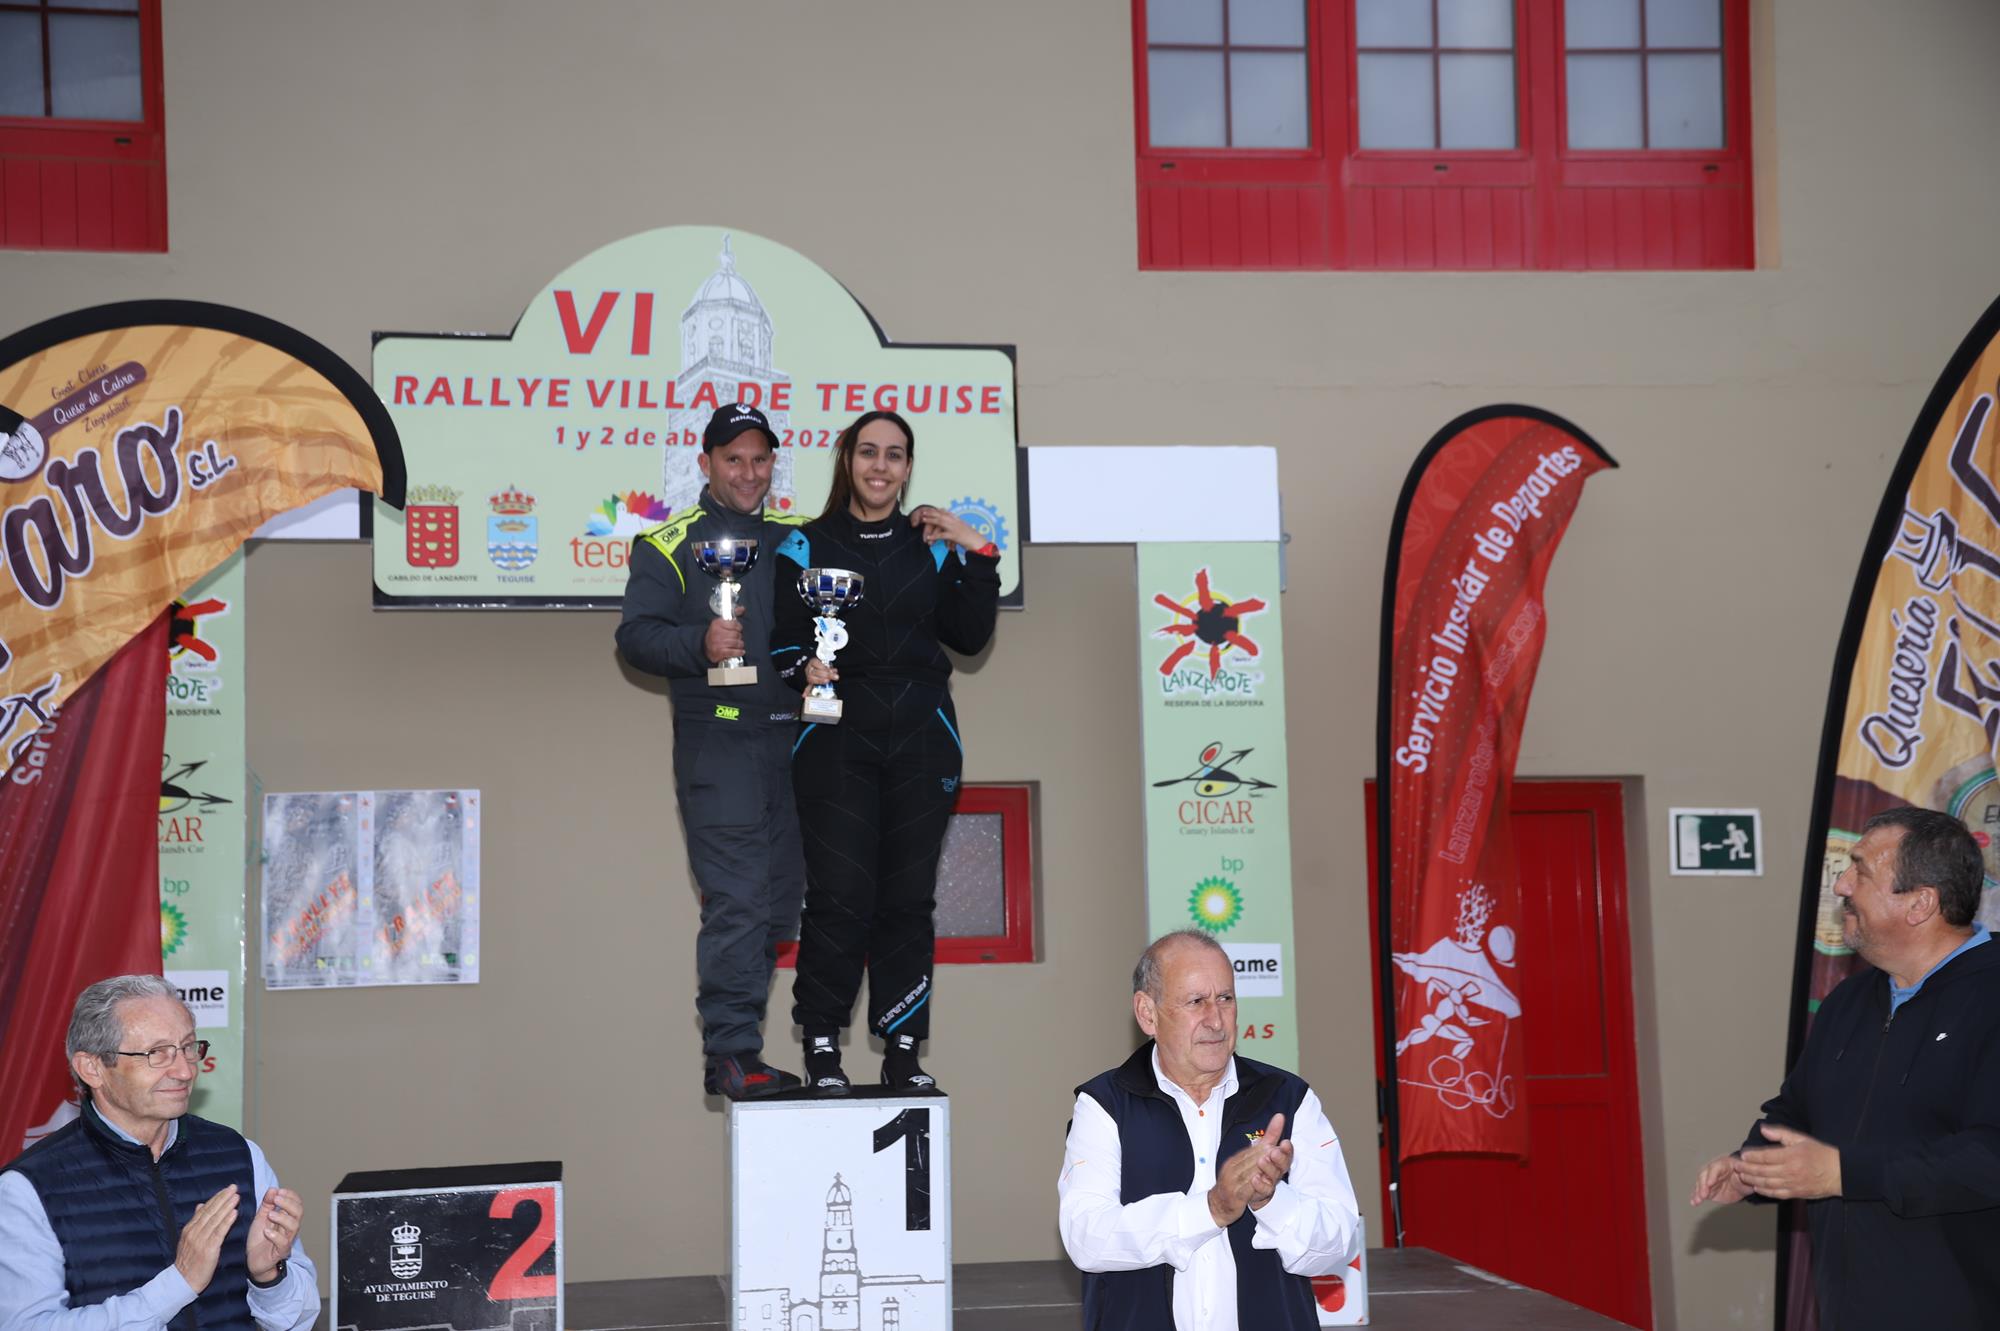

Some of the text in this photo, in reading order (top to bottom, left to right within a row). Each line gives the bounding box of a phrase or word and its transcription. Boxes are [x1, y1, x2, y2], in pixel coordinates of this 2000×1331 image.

[553, 290, 655, 357] VI
[53, 372, 135, 425] Queso de Cabra
[393, 375, 1003, 414] RALLYE VILLA DE TEGUISE
[555, 426, 566, 445] 1
[576, 431, 591, 450] y
[600, 426, 616, 446] 2
[624, 426, 657, 447] de
[1490, 445, 1582, 534] Deportes
[2, 408, 182, 608] aro
[661, 526, 681, 543] OMP
[1473, 526, 1515, 564] de
[387, 574, 478, 582] CABILDO DE LANZAROTE
[496, 575, 536, 583] TEGUISE
[1162, 668, 1253, 695] LANZAROTE
[176, 708, 221, 717] BIOSFERA
[715, 704, 740, 720] OMP
[1163, 700, 1265, 708] RESERVA DE LA BIOSFERA
[1396, 655, 1458, 775] Servicio
[1178, 800, 1255, 825] CICAR
[157, 816, 204, 843] CAR
[1179, 826, 1256, 836] Canary Islands Car
[187, 845, 205, 854] Car
[1221, 855, 1245, 875] bp
[163, 877, 191, 896] bp
[1233, 958, 1278, 973] ame
[175, 986, 225, 1002] ame
[1242, 1023, 1276, 1040] AS
[872, 1107, 931, 1232] 1
[486, 1186, 557, 1302] 2
[363, 1279, 449, 1294] AYUNTAMIENTO
[375, 1290, 437, 1303] DE TEGUISE
